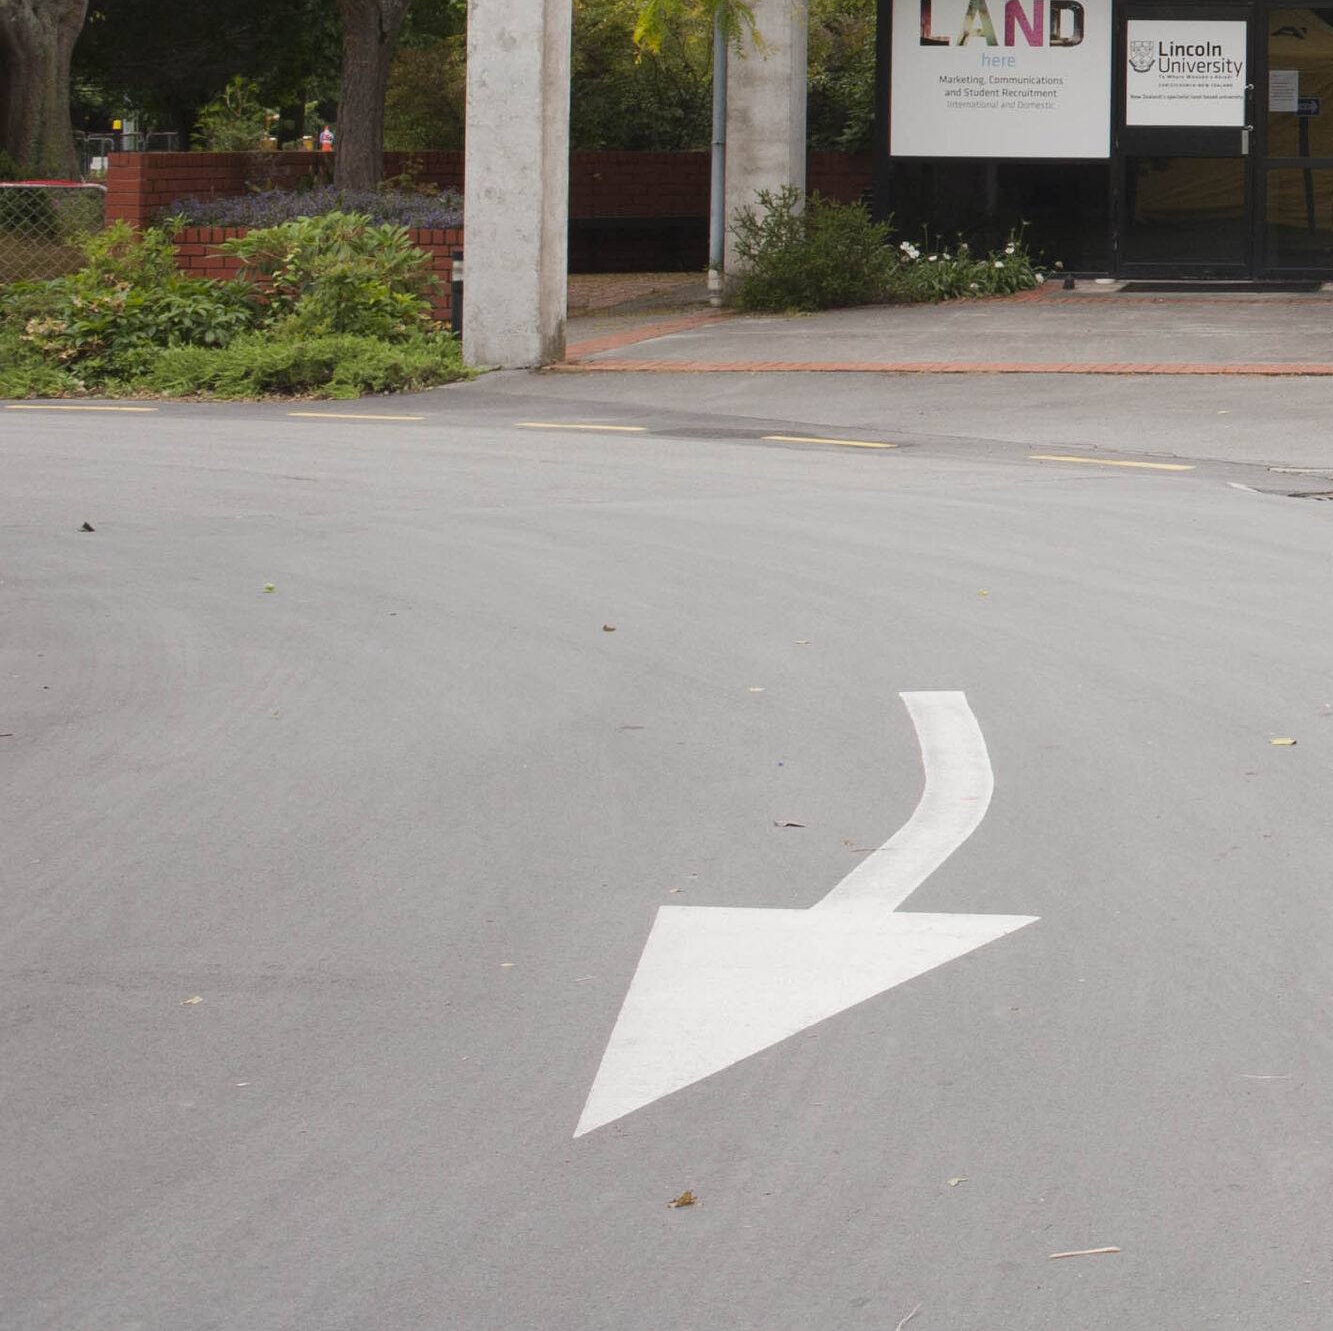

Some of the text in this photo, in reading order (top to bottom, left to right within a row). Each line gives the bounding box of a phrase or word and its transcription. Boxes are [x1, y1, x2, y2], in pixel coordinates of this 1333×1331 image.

[1158, 41, 1222, 57] Lincoln
[981, 53, 1016, 67] here
[1158, 57, 1243, 78] University
[939, 75, 1064, 86] Marketing, Communications
[944, 88, 1058, 98] and Student Recruitment
